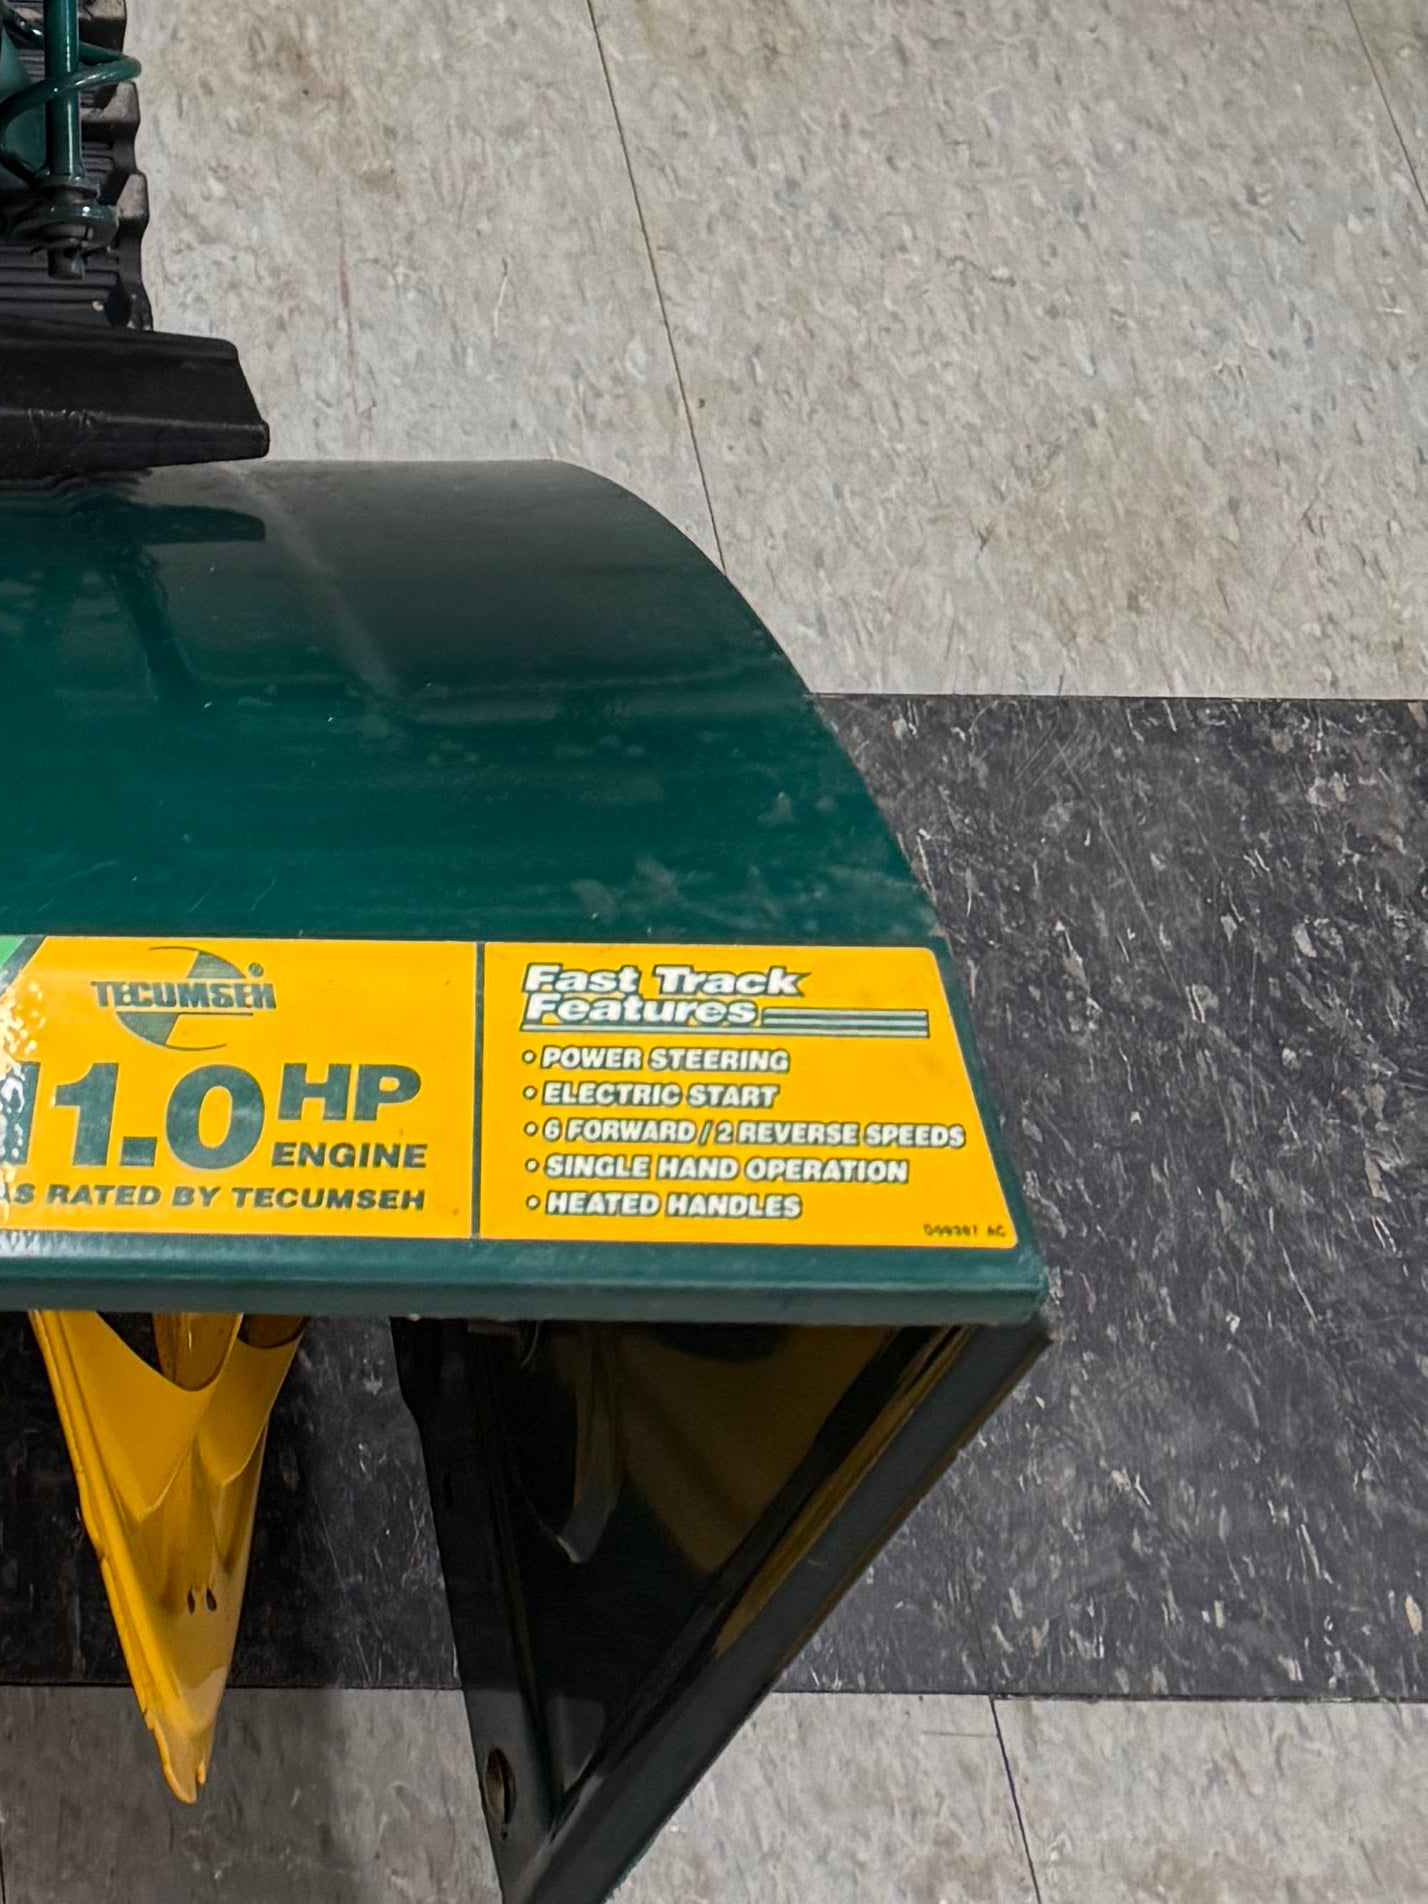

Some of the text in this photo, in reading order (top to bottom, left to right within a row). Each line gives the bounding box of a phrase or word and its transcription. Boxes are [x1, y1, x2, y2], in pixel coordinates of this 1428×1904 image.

[525, 964, 812, 997] Fast Track
[91, 979, 277, 1012] TECUMSEH
[521, 993, 758, 1025] Features
[541, 1047, 790, 1073] POWER STEERING
[278, 1062, 422, 1123] HP
[542, 1083, 779, 1108] ELECTRIC START
[543, 1120, 966, 1148] 6 FORWARD / 2 REVERSE SPEEDS
[269, 1142, 427, 1169] ENGINE
[544, 1157, 909, 1184] SINGLE HAND OPERATION
[44, 1185, 164, 1209] RATED
[170, 1186, 227, 1209] BY
[237, 1187, 426, 1211] TECUMSEH
[546, 1193, 802, 1219] HEATED HANDLES
